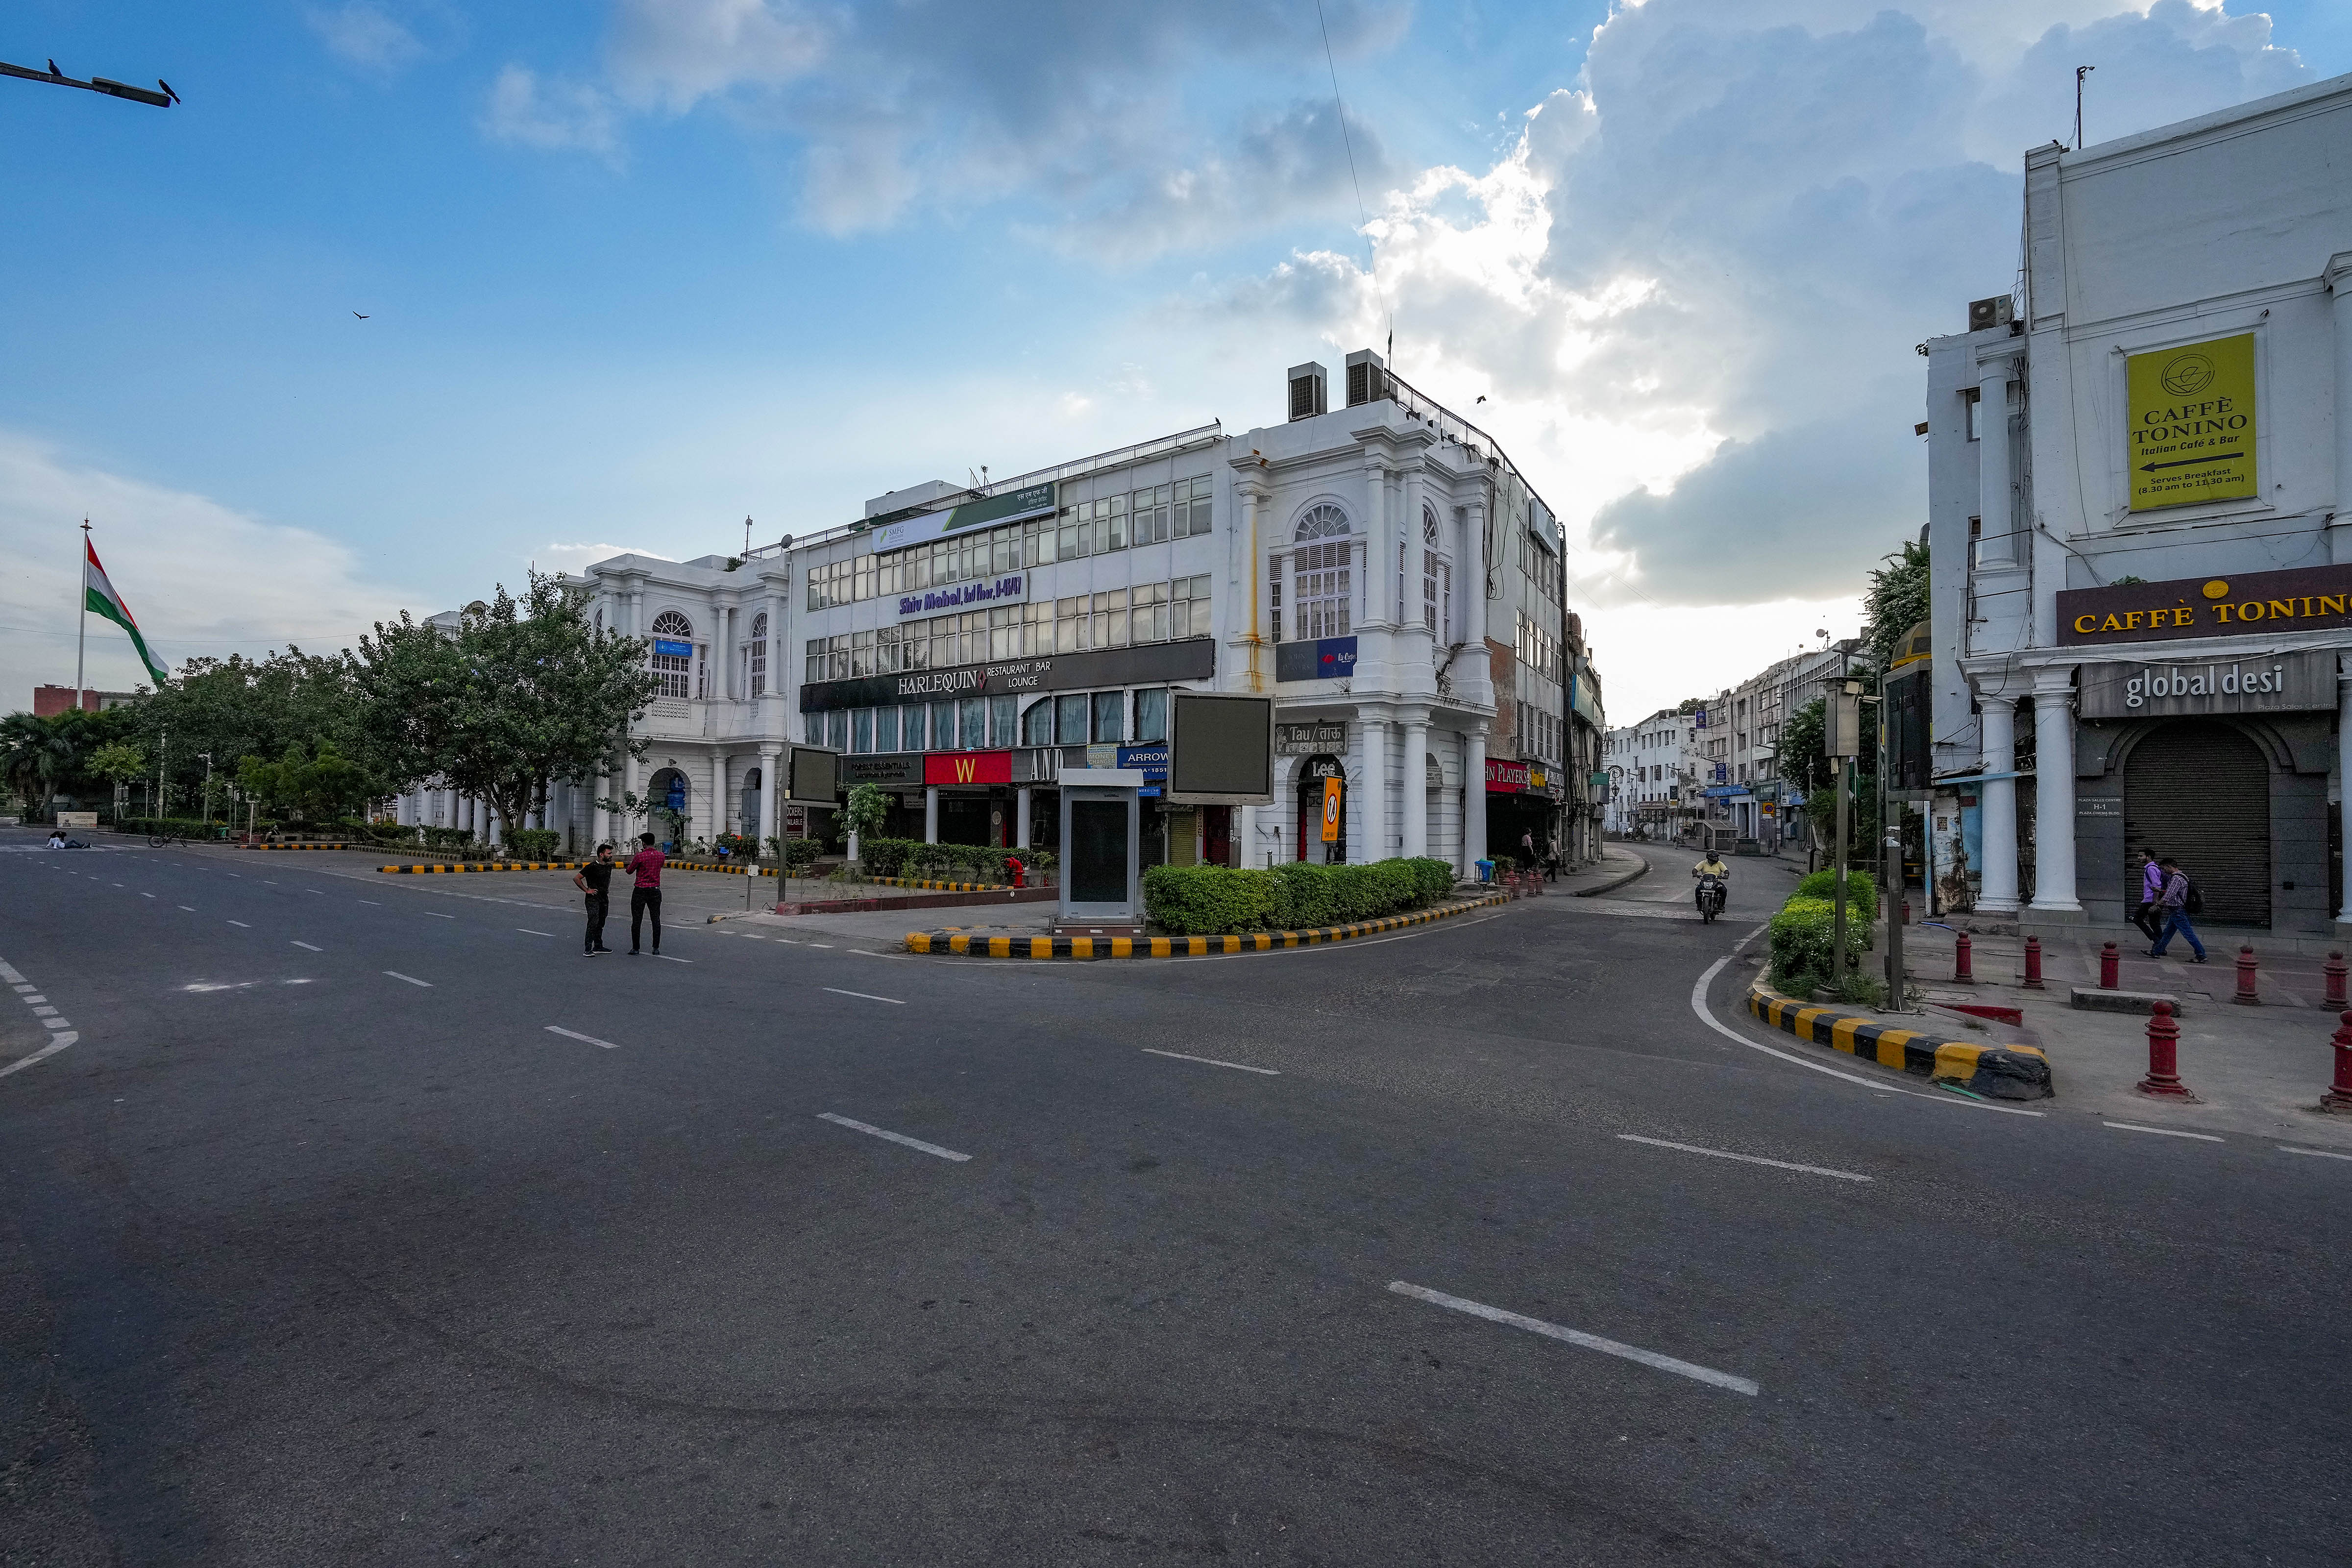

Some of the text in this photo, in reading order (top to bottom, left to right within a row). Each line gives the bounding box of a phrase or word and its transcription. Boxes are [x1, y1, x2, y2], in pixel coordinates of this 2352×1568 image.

[2144, 397, 2233, 424] CAFFÈ
[2132, 415, 2247, 444] TONINO
[2141, 445, 2176, 455] Italian
[2180, 439, 2205, 450] Café
[2138, 486, 2162, 495] (8.30
[2195, 477, 2222, 487] 11.30
[2225, 474, 2244, 482] am)
[2151, 468, 2231, 484] Serves Breakfast
[889, 526, 904, 536] SMFG
[899, 596, 922, 614] Shiv
[924, 588, 963, 610] Mahal,
[964, 586, 976, 603] 2nd
[996, 576, 1021, 597] B-45/47
[2075, 594, 2352, 633] CAFFÈ TONIN
[987, 662, 1050, 677] RESTAURANT BAR
[898, 670, 977, 694] HARLEQUIN
[1008, 676, 1037, 687] LOUNGE
[2126, 664, 2282, 707] global desi
[1290, 727, 1310, 741] Tau
[1030, 749, 1064, 780] AND
[1128, 753, 1168, 762] ARROW
[956, 759, 976, 783] W
[1313, 761, 1335, 776] Lee
[1497, 763, 1527, 784] PLAYERS
